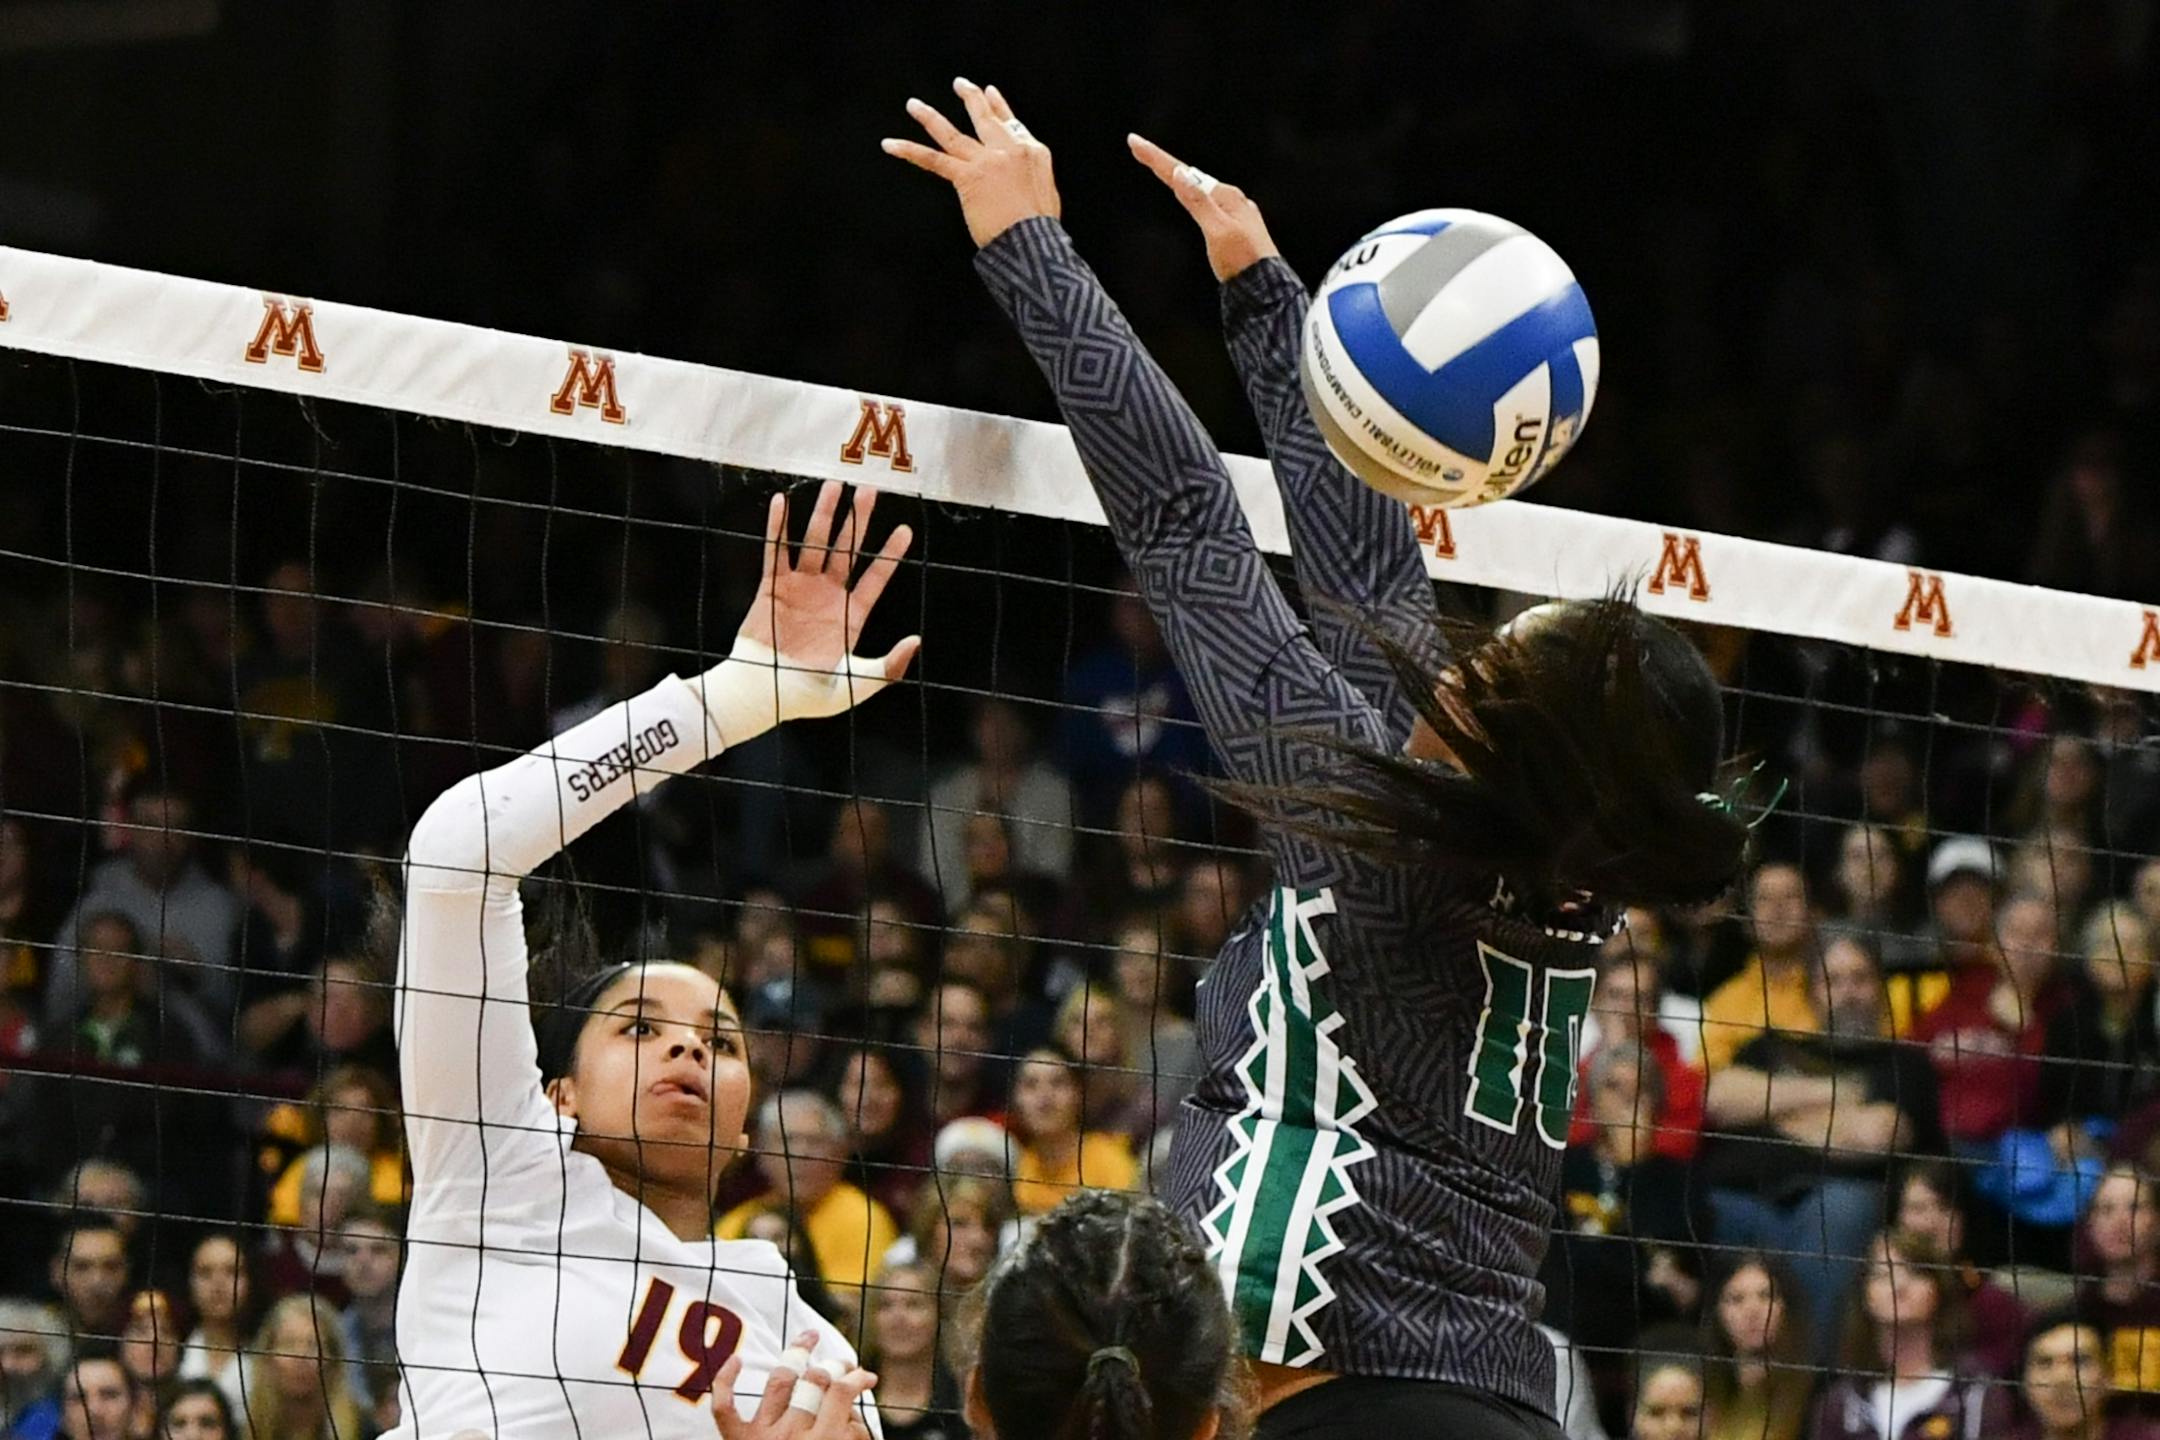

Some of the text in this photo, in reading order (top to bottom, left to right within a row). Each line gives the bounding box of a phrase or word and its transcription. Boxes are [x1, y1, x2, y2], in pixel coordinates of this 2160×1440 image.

[245, 294, 324, 373] M
[550, 347, 626, 424] M
[841, 397, 913, 473] M
[1408, 504, 1456, 560] M
[1648, 532, 1709, 602] M
[1894, 570, 1953, 637] M
[568, 718, 679, 802] GOPHERS
[614, 1274, 746, 1406] 19
